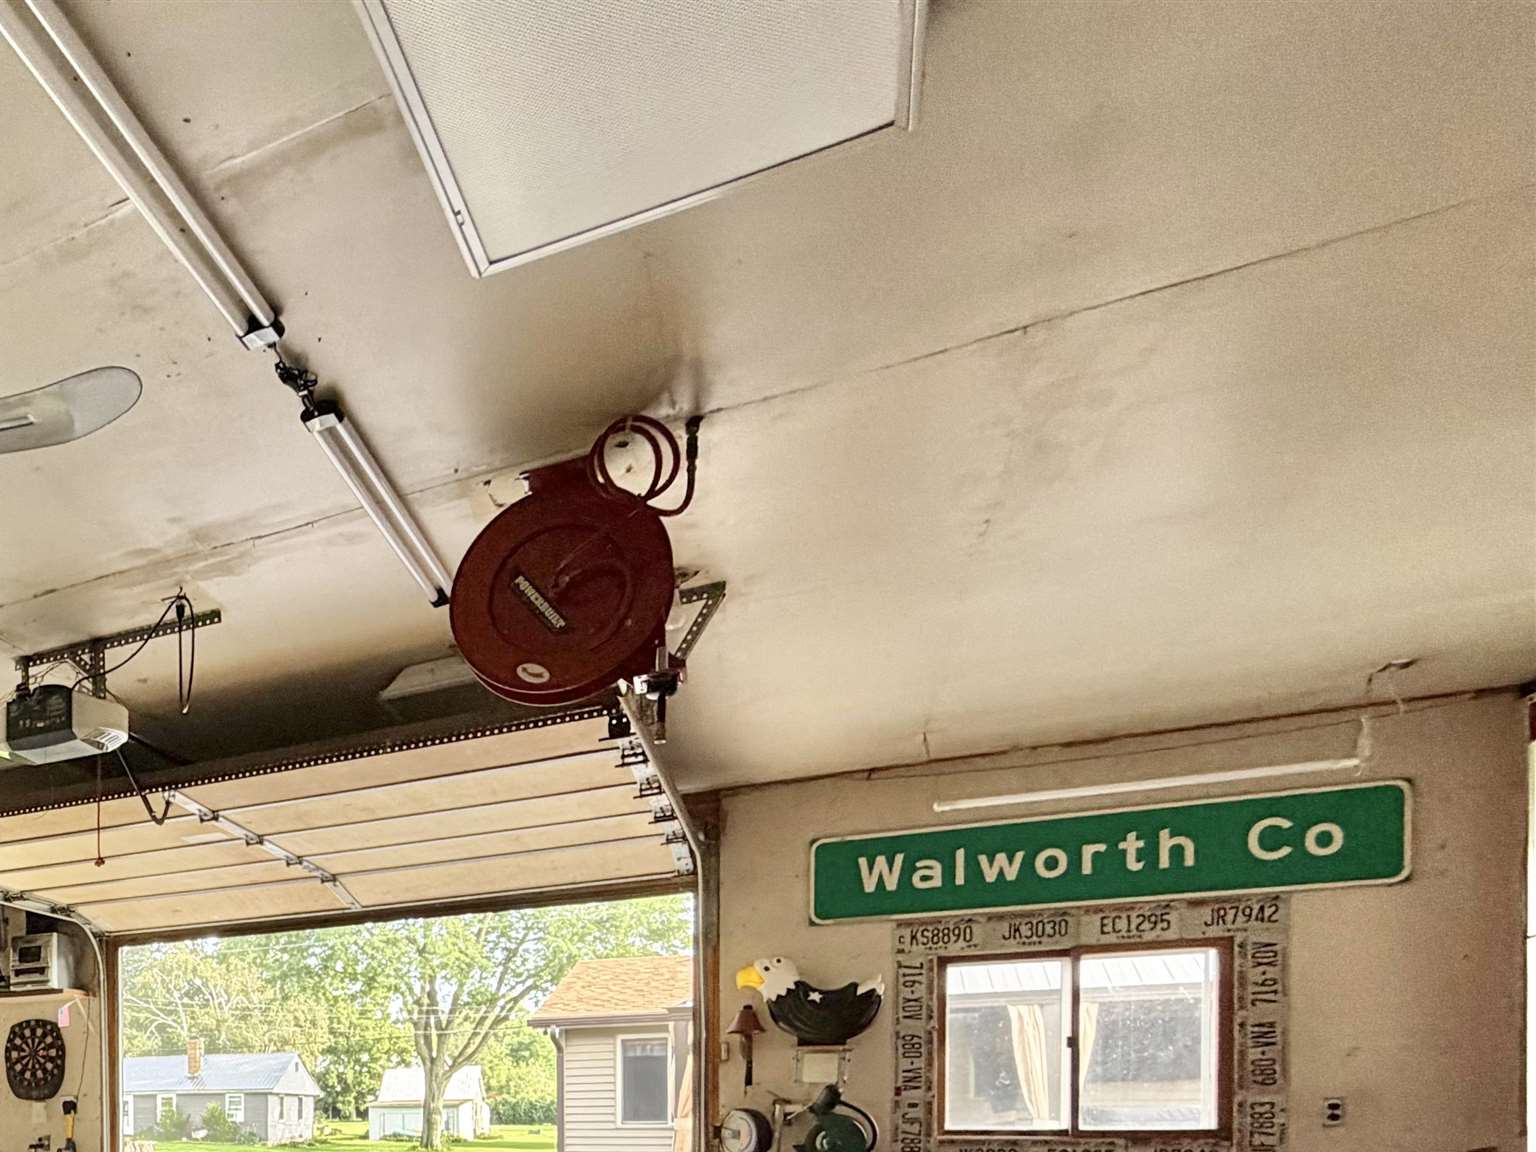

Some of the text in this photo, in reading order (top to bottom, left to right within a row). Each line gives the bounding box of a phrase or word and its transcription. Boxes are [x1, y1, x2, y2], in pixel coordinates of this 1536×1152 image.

[858, 816, 1345, 893] Walworth Co
[909, 925, 974, 947] KS8890
[1001, 918, 1069, 941] JK3030
[1099, 912, 1172, 935] EC1295
[1203, 903, 1280, 928] JR7942
[901, 962, 924, 1021] 716-XDV
[1250, 941, 1280, 1008] 716-XDV
[901, 1034, 923, 1092] 680-VNA
[1250, 1021, 1278, 1086] 680-VNA
